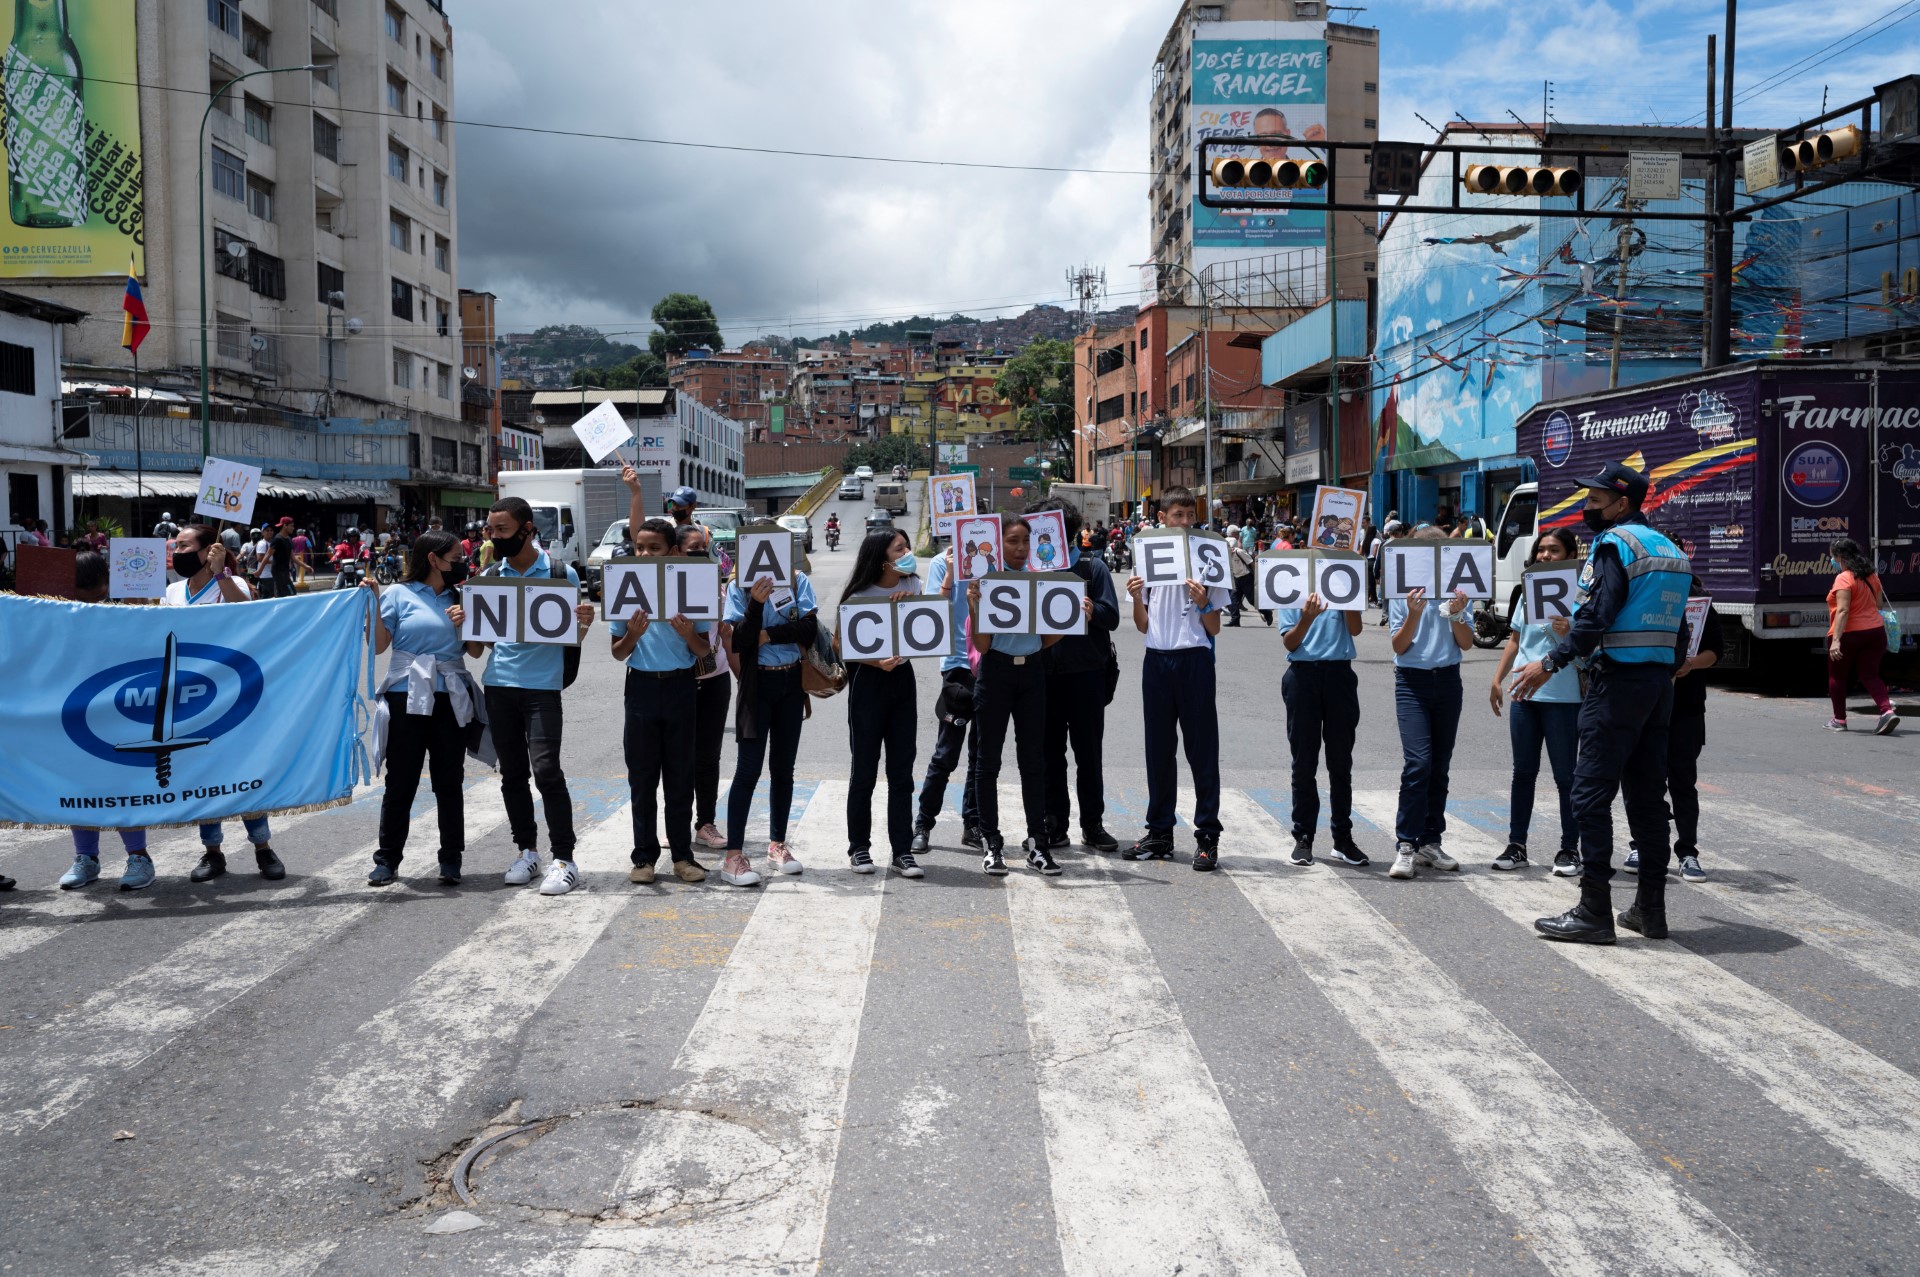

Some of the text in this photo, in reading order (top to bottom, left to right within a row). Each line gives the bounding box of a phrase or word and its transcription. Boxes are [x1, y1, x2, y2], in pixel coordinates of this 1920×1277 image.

[1195, 46, 1322, 70] JOSÉ VICENTE
[25, 74, 65, 129] Real.
[1212, 72, 1312, 98] RANGEL
[14, 85, 79, 187] Vida Real.
[1196, 111, 1252, 127] SUCRE
[26, 151, 67, 198] Vida
[42, 162, 79, 209] Vida
[1220, 190, 1293, 199] VOTA POR SUCRE
[1578, 407, 1671, 440] Farmacia
[1799, 457, 1832, 465] SUAF
[202, 485, 239, 507] Alto
[744, 540, 786, 583] A
[1144, 542, 1225, 582] ES
[1396, 552, 1488, 597] LA
[611, 571, 709, 619] AL
[1265, 563, 1361, 605] CO
[1532, 577, 1572, 620] R
[471, 593, 572, 639] NO
[987, 585, 1081, 631] SO
[847, 607, 945, 655] CO
[59, 779, 264, 809] MINISTERIO PÚBLICO
